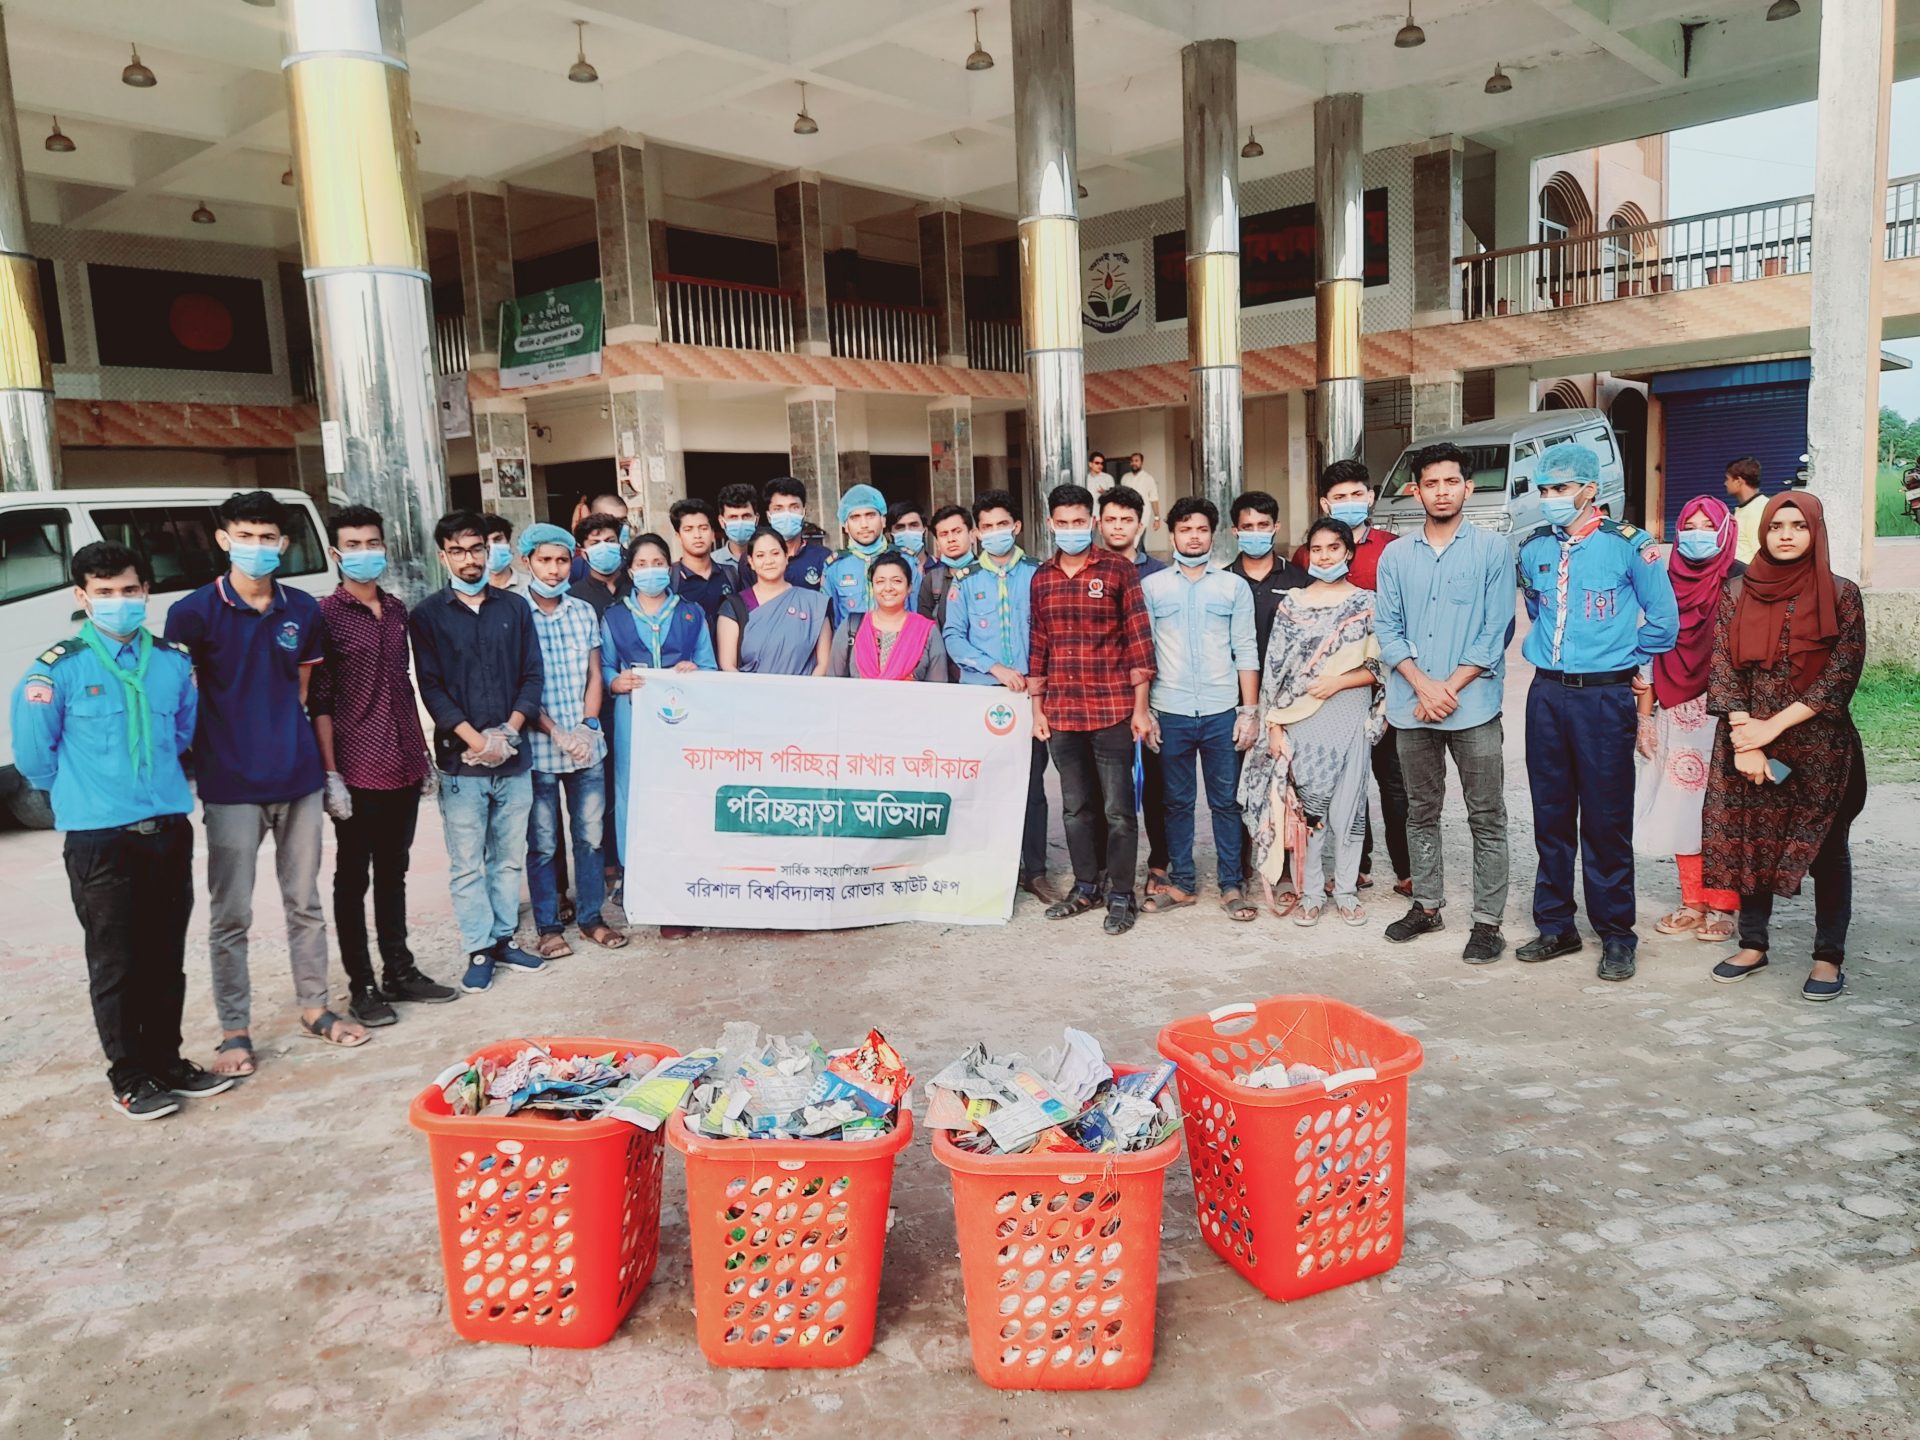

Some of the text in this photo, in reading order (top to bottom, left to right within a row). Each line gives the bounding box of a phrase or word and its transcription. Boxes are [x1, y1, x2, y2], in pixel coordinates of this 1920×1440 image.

[682, 744, 981, 780] ক্যাম্পাস পরিচ্ছন্ন রাখার অঙ্গীকারে
[726, 788, 944, 831] পরিচ্ছন্নতা অভিযান
[780, 862, 870, 878] সার্বিক সহযোগিতায়
[685, 875, 961, 901] বরিশাল বিশ্ববিদ্যালয় রোভার স্কাউট গ্রুপ
